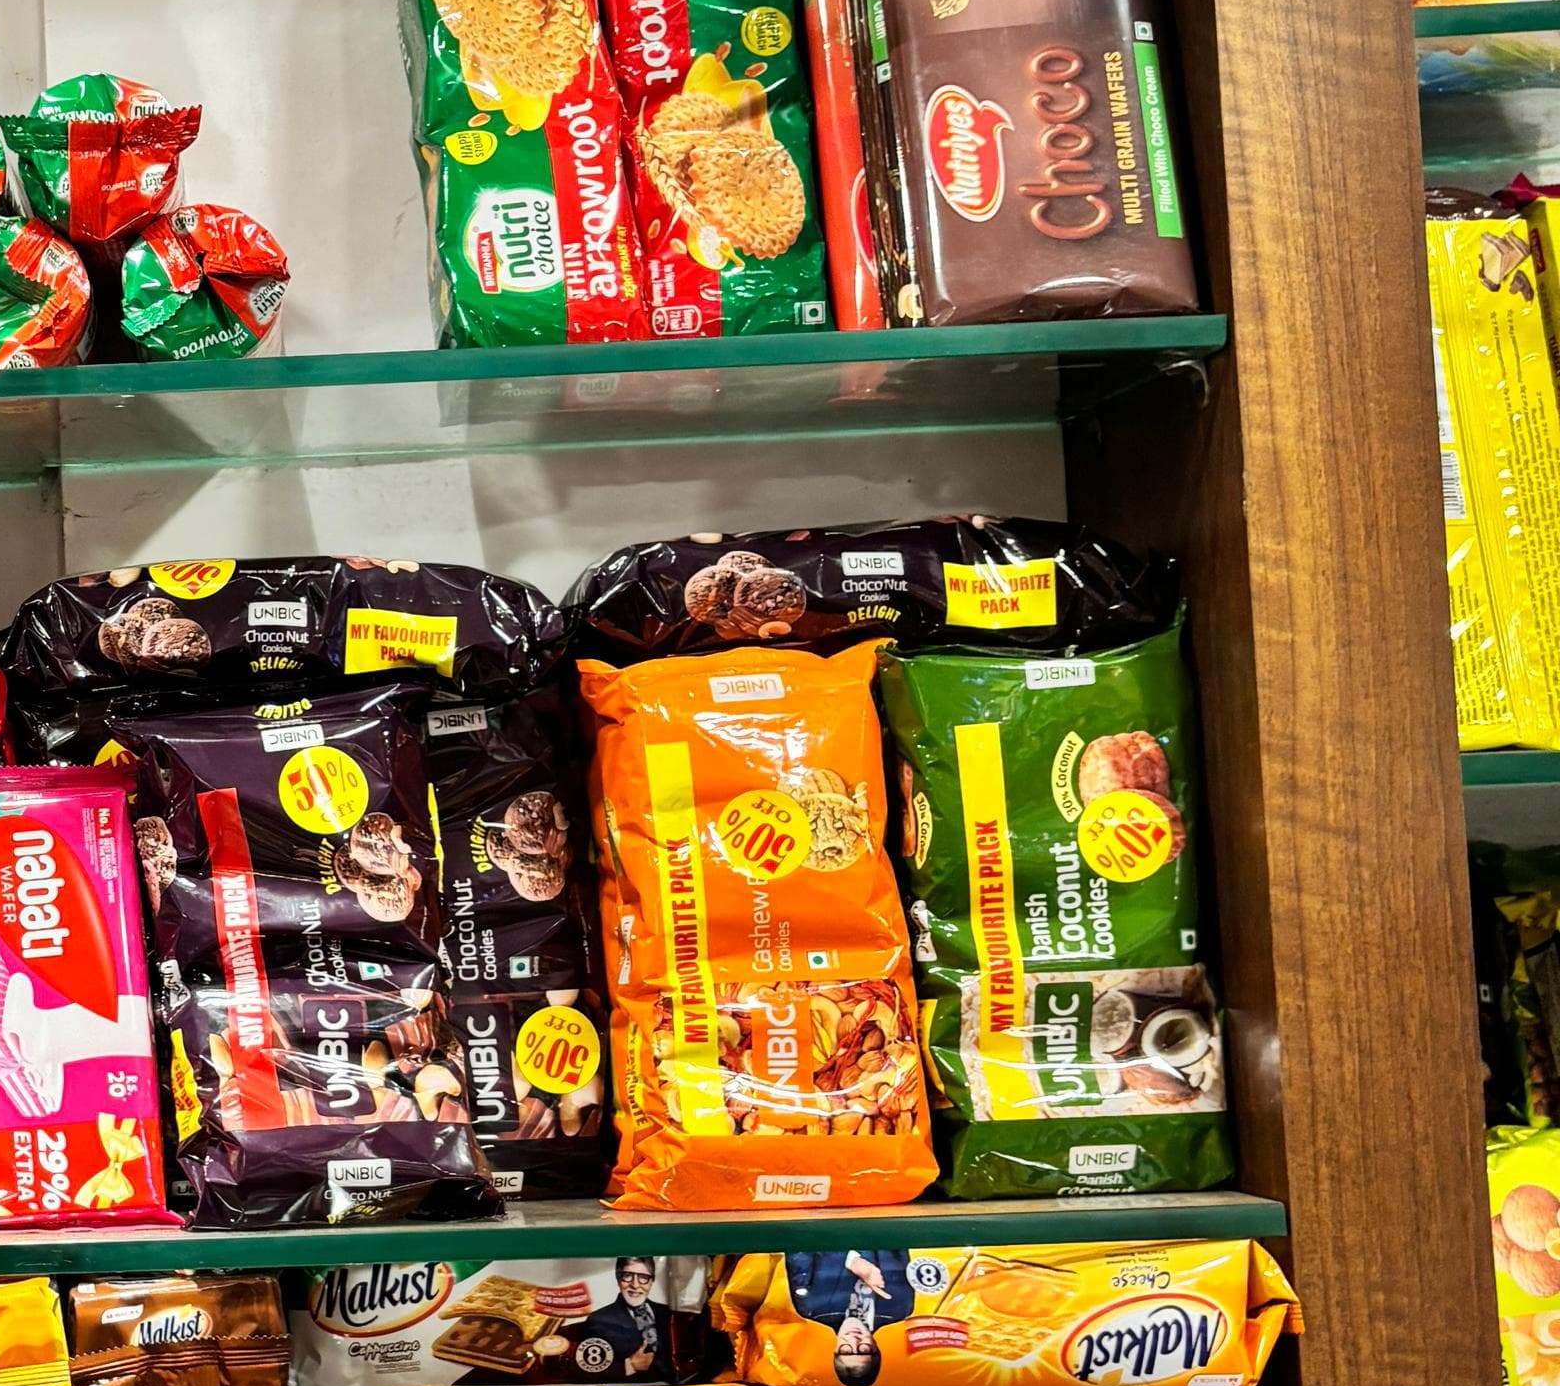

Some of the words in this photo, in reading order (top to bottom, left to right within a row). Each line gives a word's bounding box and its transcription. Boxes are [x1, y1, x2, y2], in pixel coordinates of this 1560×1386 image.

[1104, 50, 1130, 112] WAFERS
[1144, 66, 1162, 104] Cream
[1017, 45, 1114, 241] Choco
[1112, 114, 1137, 171] GRAIN
[1150, 105, 1166, 144] Choco
[942, 98, 986, 206] Nutriyes
[1153, 146, 1169, 176] With
[557, 98, 620, 301] arrowroot
[1122, 173, 1145, 226] MULTI
[1157, 178, 1174, 215] Filled
[483, 233, 498, 290] BRITANNIA
[493, 200, 529, 280] nutri
[538, 199, 556, 278] choice
[566, 243, 584, 298] THIN
[170, 323, 243, 360] arrowroot
[841, 577, 882, 593] Choco
[884, 579, 908, 593] Nut
[847, 555, 897, 572] UNIBIC
[949, 577, 967, 593] MY
[252, 607, 302, 621] UNIBIC
[846, 606, 902, 625] DELIGHT
[858, 593, 891, 603] Cookies
[980, 597, 1020, 615] PACK
[244, 629, 284, 645] Choco
[285, 629, 310, 645] Nut
[261, 644, 293, 653] Cookies
[350, 624, 371, 641] MY
[373, 625, 452, 647] FAVOURITE
[718, 678, 780, 699] UNIBIC
[268, 728, 321, 747] UNIBIC
[431, 711, 484, 730] UNIBIC
[98, 806, 111, 826] No.
[285, 767, 358, 814] 50%
[100, 827, 110, 836] 1
[725, 807, 798, 873] 50%
[973, 820, 1000, 886] PACK
[666, 835, 696, 894] PACK
[0, 865, 17, 924] WAFER
[11, 829, 72, 960] nabati
[223, 874, 248, 925] PACK
[453, 876, 475, 917] Nut
[1086, 877, 1116, 958] Cookies
[751, 892, 773, 974] Cashew
[776, 920, 793, 972] Cookies
[980, 889, 1013, 1002] FAVOURITE
[1024, 891, 1053, 957] Danish
[456, 919, 479, 982] Choco
[482, 928, 498, 982] Cookies
[674, 896, 708, 1015] FAVOURITE
[468, 1014, 506, 1123] UNIBIC
[524, 1030, 590, 1086] 50%
[125, 1073, 138, 1096] Rs.
[36, 1128, 71, 1209] 29%
[333, 1165, 386, 1182] UNIBIC
[1074, 1150, 1132, 1168] UNIBIC
[762, 1180, 825, 1197] UNIBIC
[314, 1262, 442, 1327] Malkist
[1111, 1270, 1170, 1291] Cheese
[1077, 1304, 1222, 1381] Malkist
